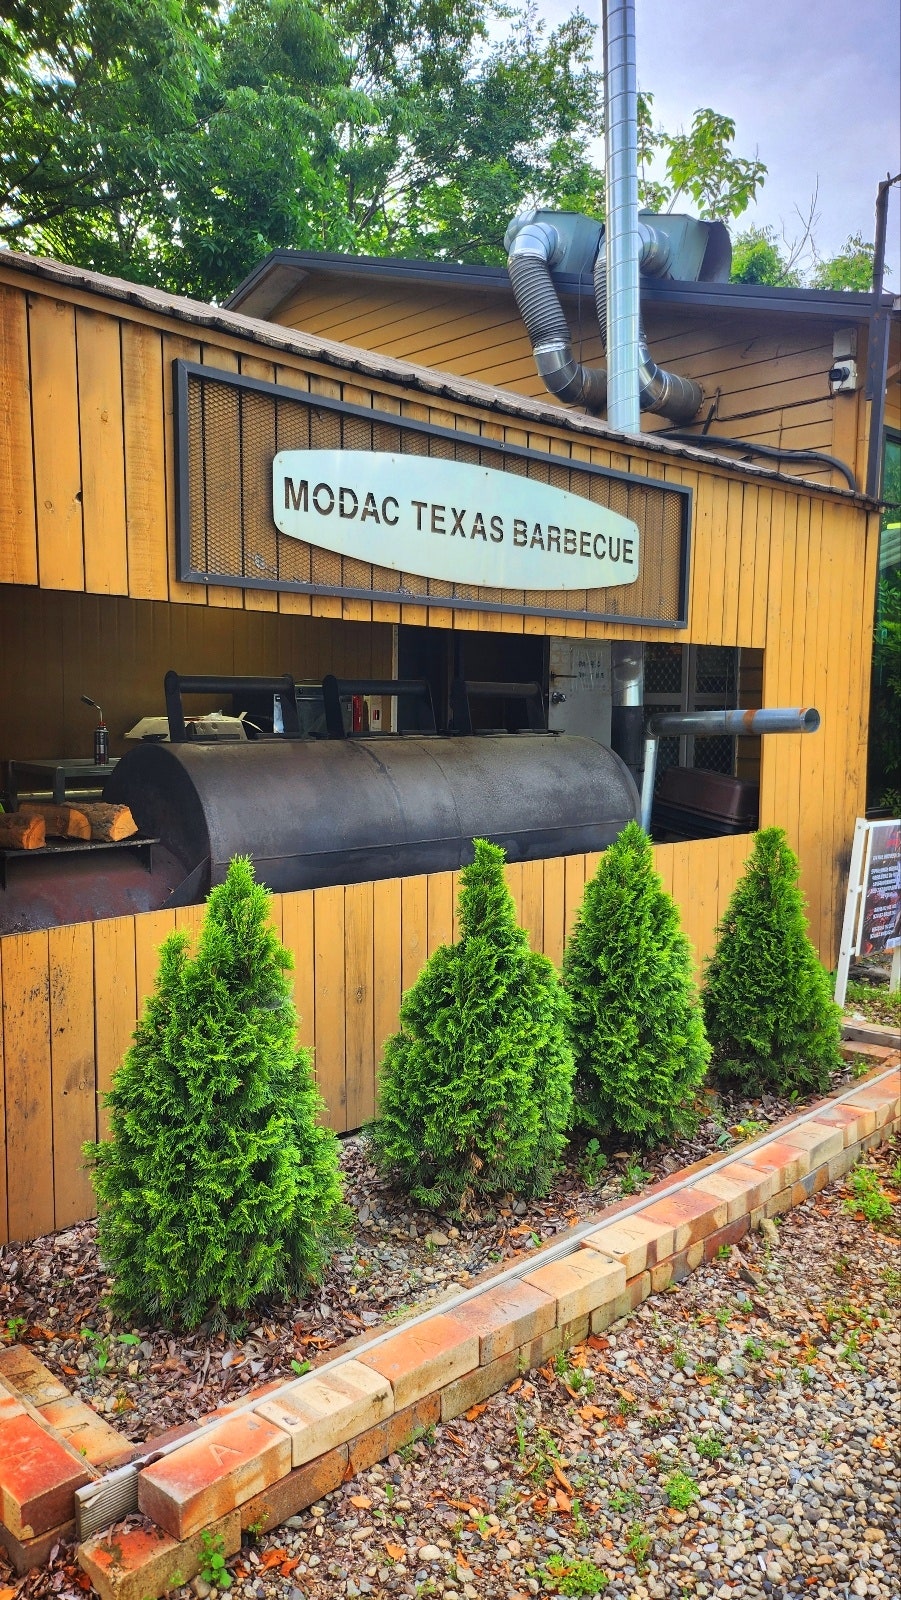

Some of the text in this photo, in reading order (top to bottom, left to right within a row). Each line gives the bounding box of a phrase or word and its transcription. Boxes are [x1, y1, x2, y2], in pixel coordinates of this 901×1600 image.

[284, 476, 634, 564] MODAC TEXAS BARBECUE
